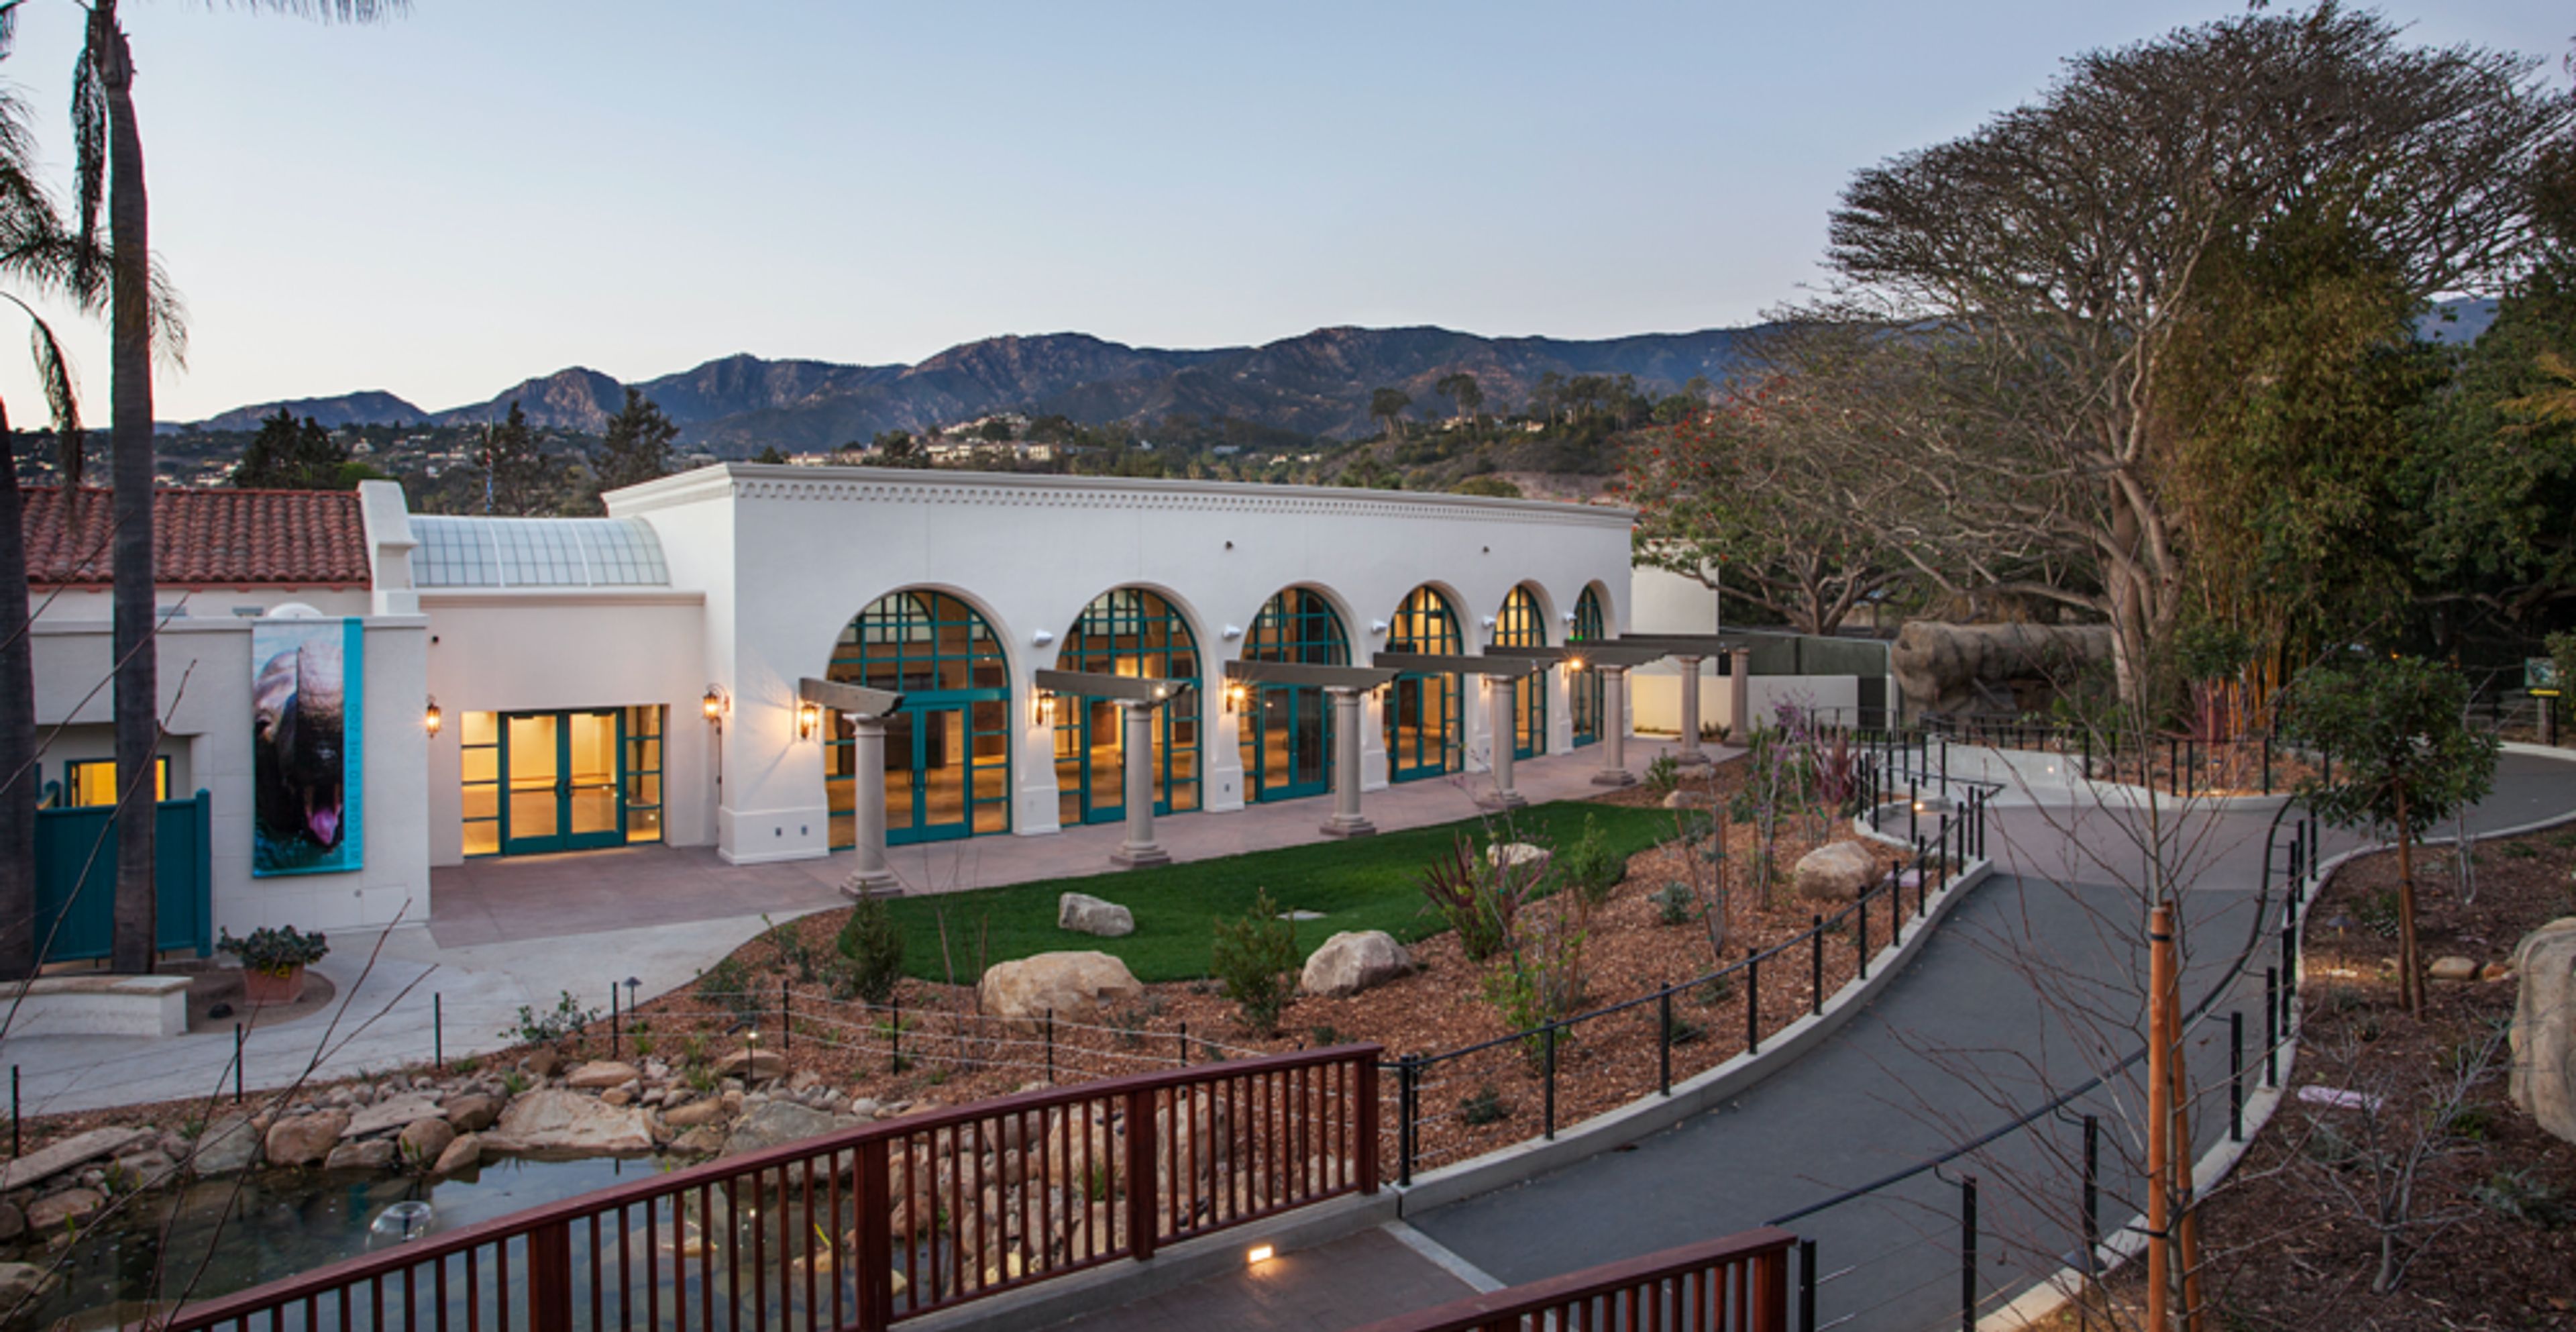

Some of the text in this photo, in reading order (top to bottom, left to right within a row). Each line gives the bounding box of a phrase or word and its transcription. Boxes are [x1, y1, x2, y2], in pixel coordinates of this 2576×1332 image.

[347, 703, 360, 859] WELCOME TO THE ZOO
